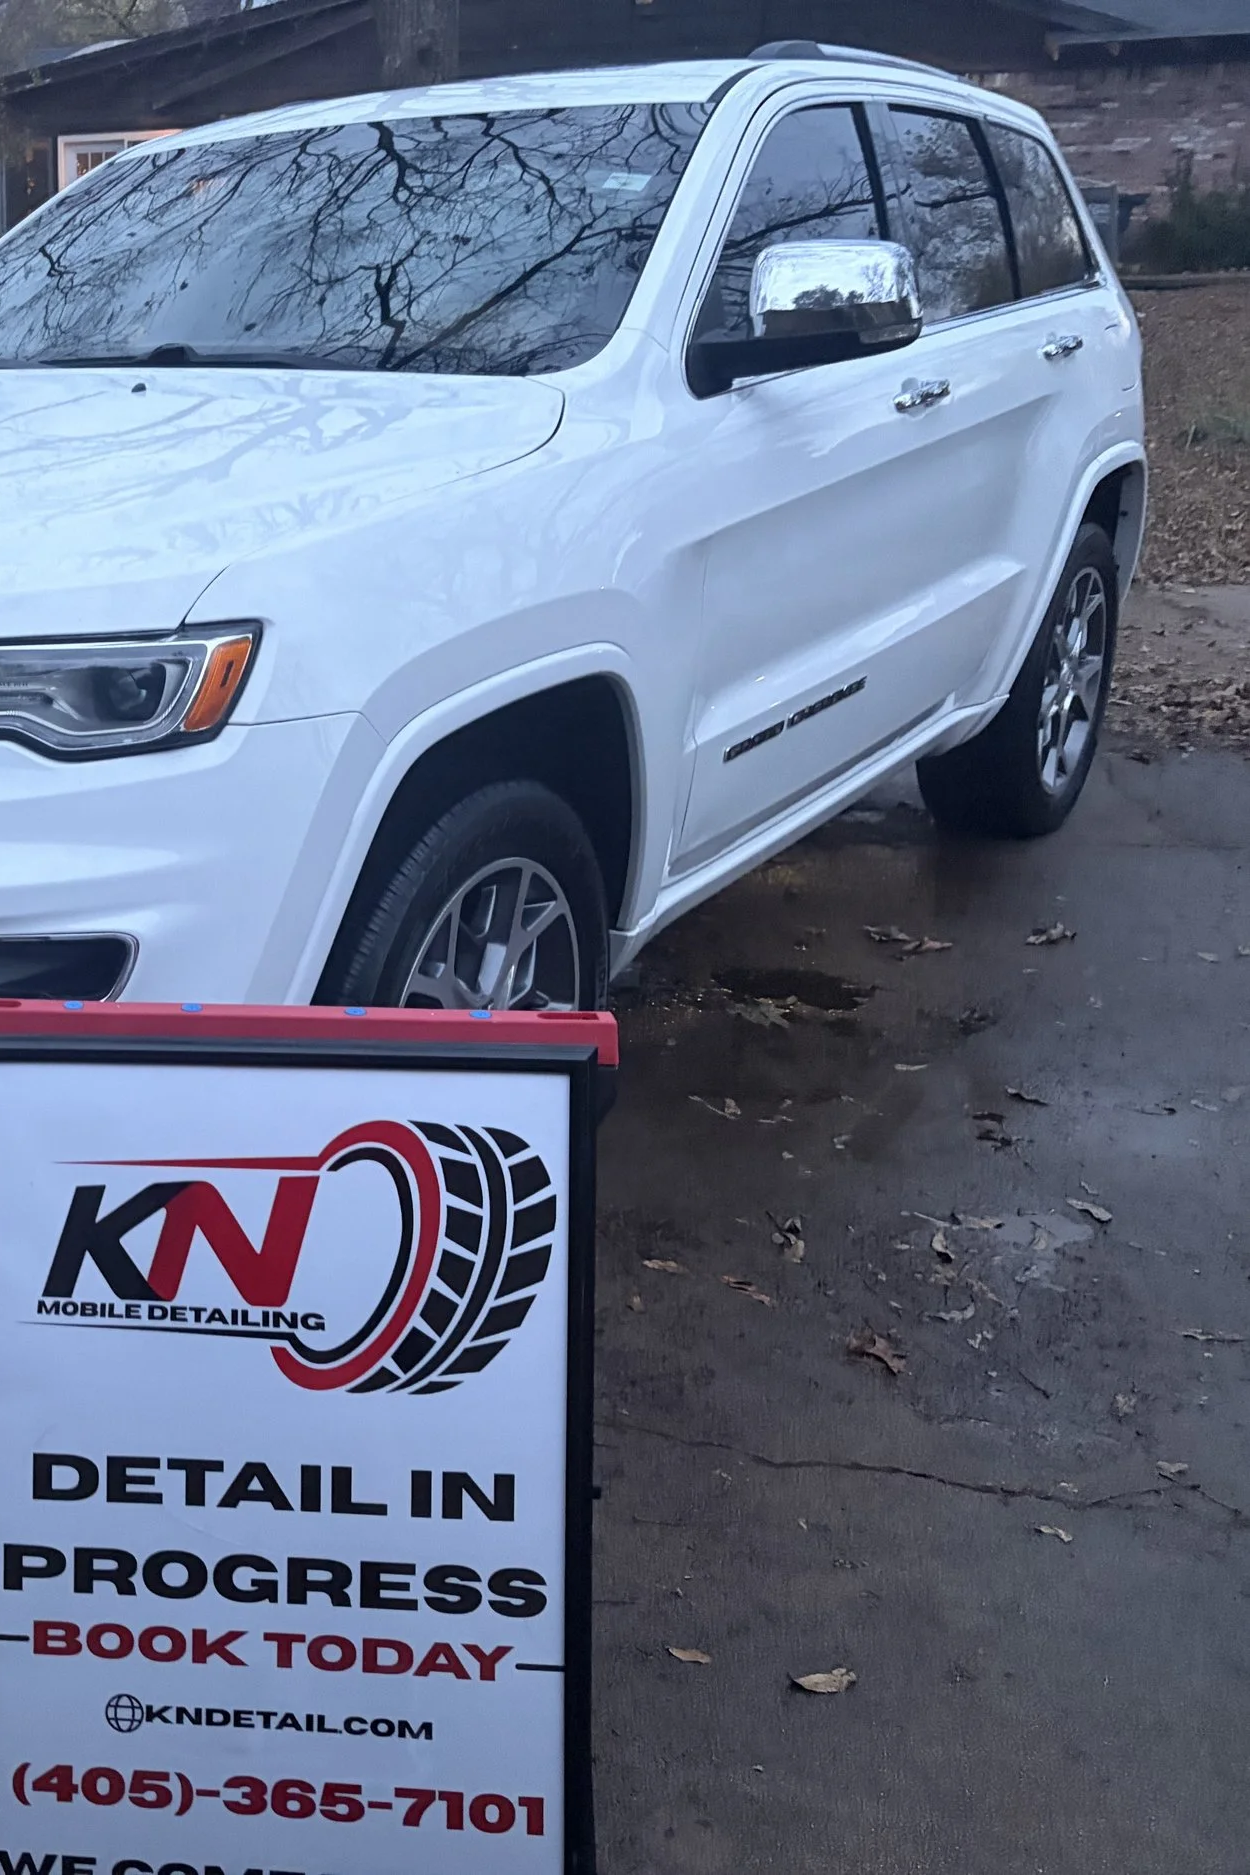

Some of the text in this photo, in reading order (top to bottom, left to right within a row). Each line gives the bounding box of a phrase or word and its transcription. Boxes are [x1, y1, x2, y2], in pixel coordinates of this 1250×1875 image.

[41, 1175, 321, 1308] KN
[36, 1299, 327, 1332] MOBILE DETAILING
[31, 1452, 516, 1522] DETAIL IN
[2, 1542, 549, 1618] PROGRESS
[32, 1619, 515, 1682] BOOK TODAY
[144, 1703, 435, 1741] KNDETAIL.COM
[11, 1761, 546, 1837] (405)-365-7101
